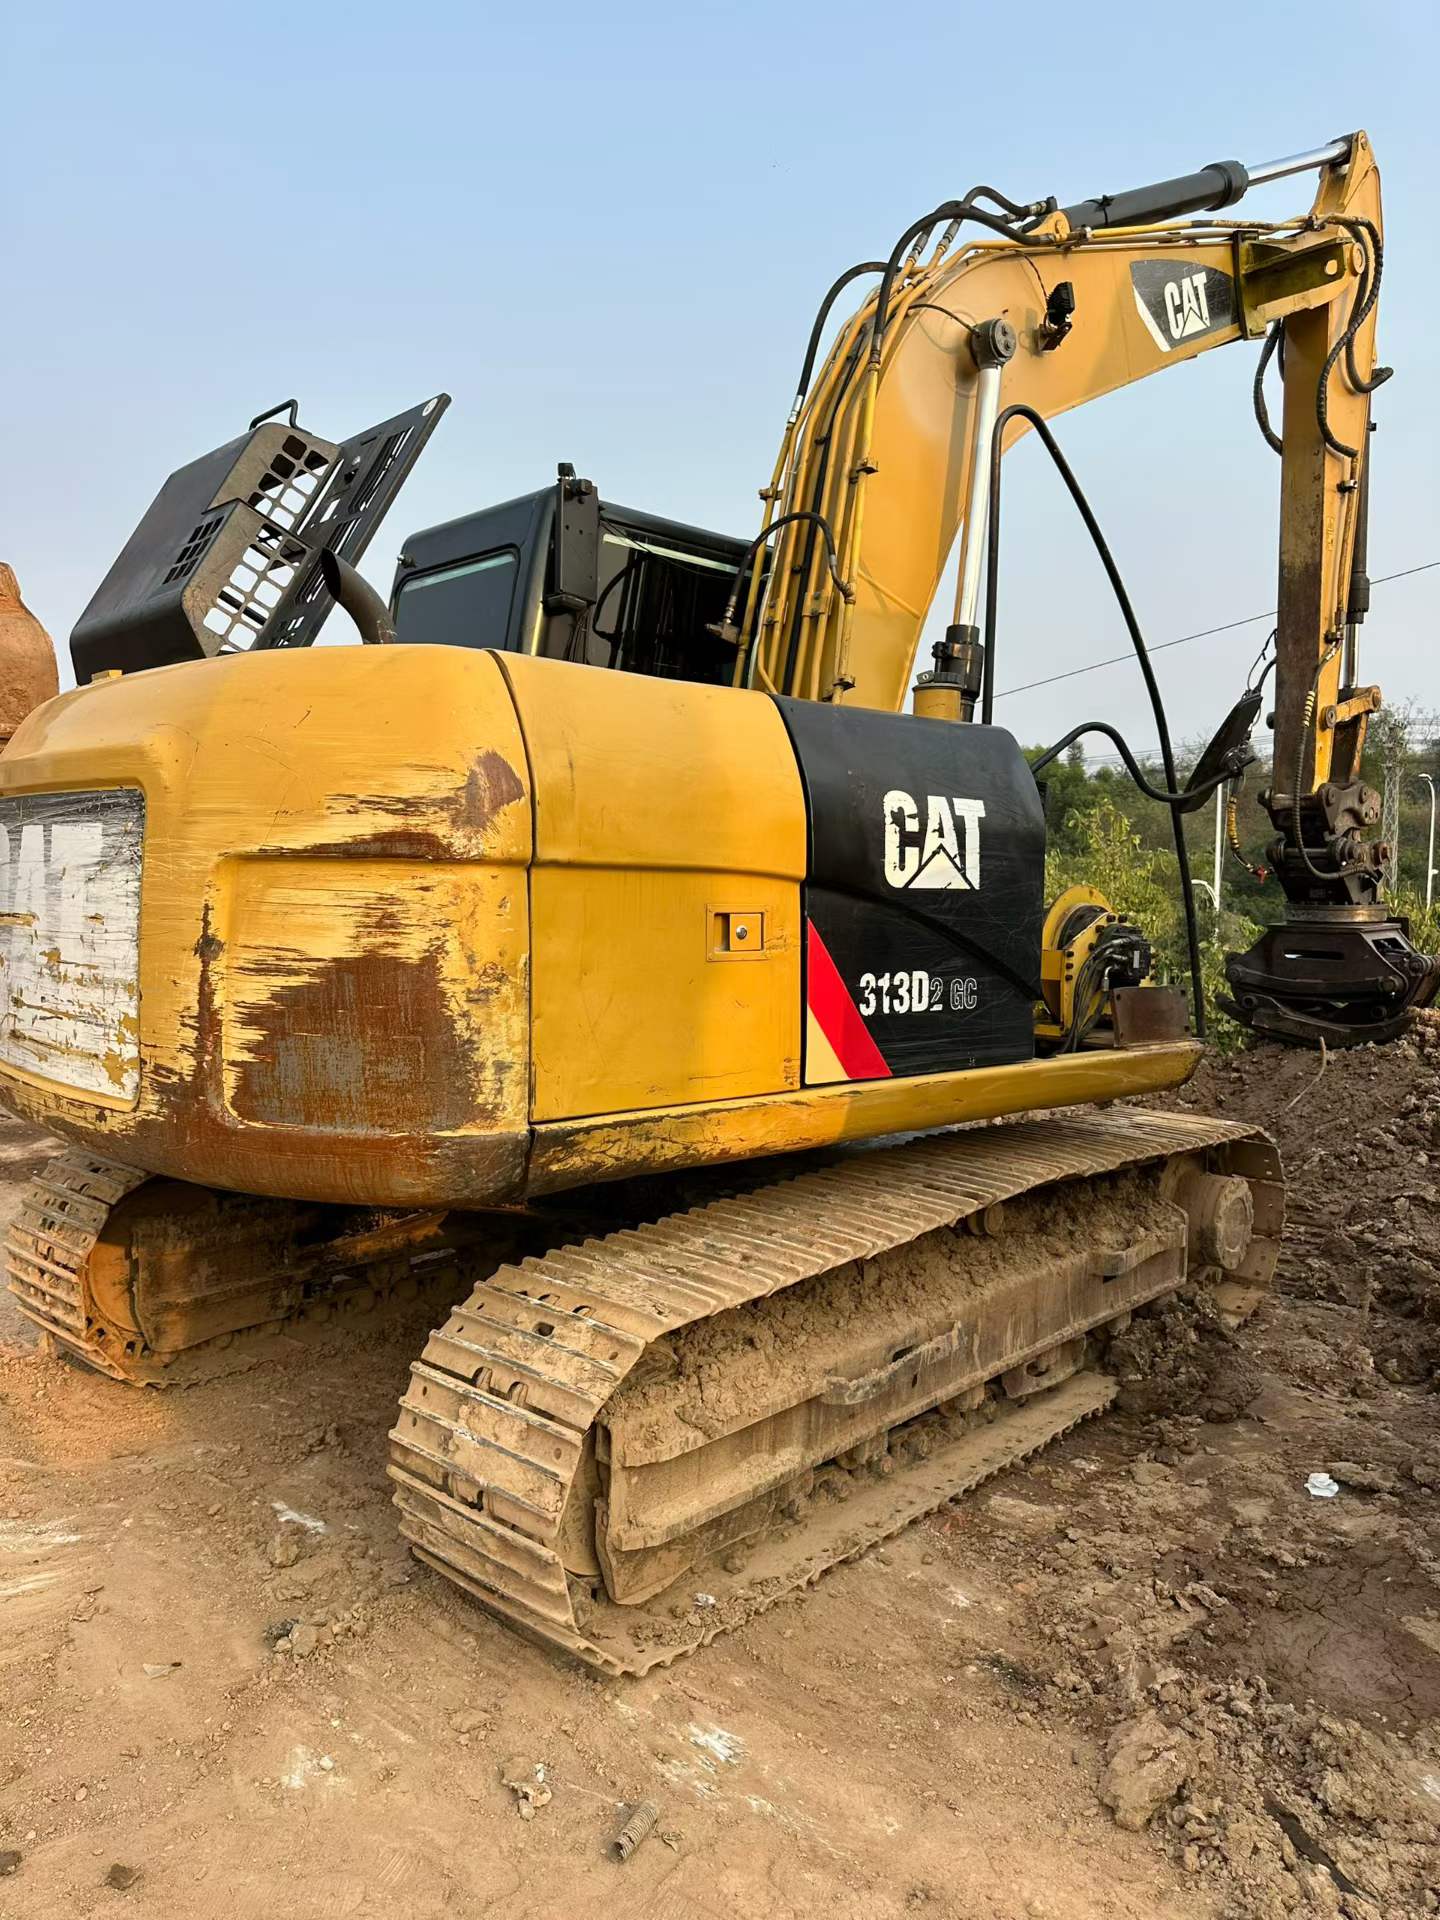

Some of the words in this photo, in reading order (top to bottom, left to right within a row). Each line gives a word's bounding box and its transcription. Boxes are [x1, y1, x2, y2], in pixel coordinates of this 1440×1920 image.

[1164, 271, 1210, 339] CAT
[883, 790, 986, 890] CAT
[950, 977, 978, 1011] GC
